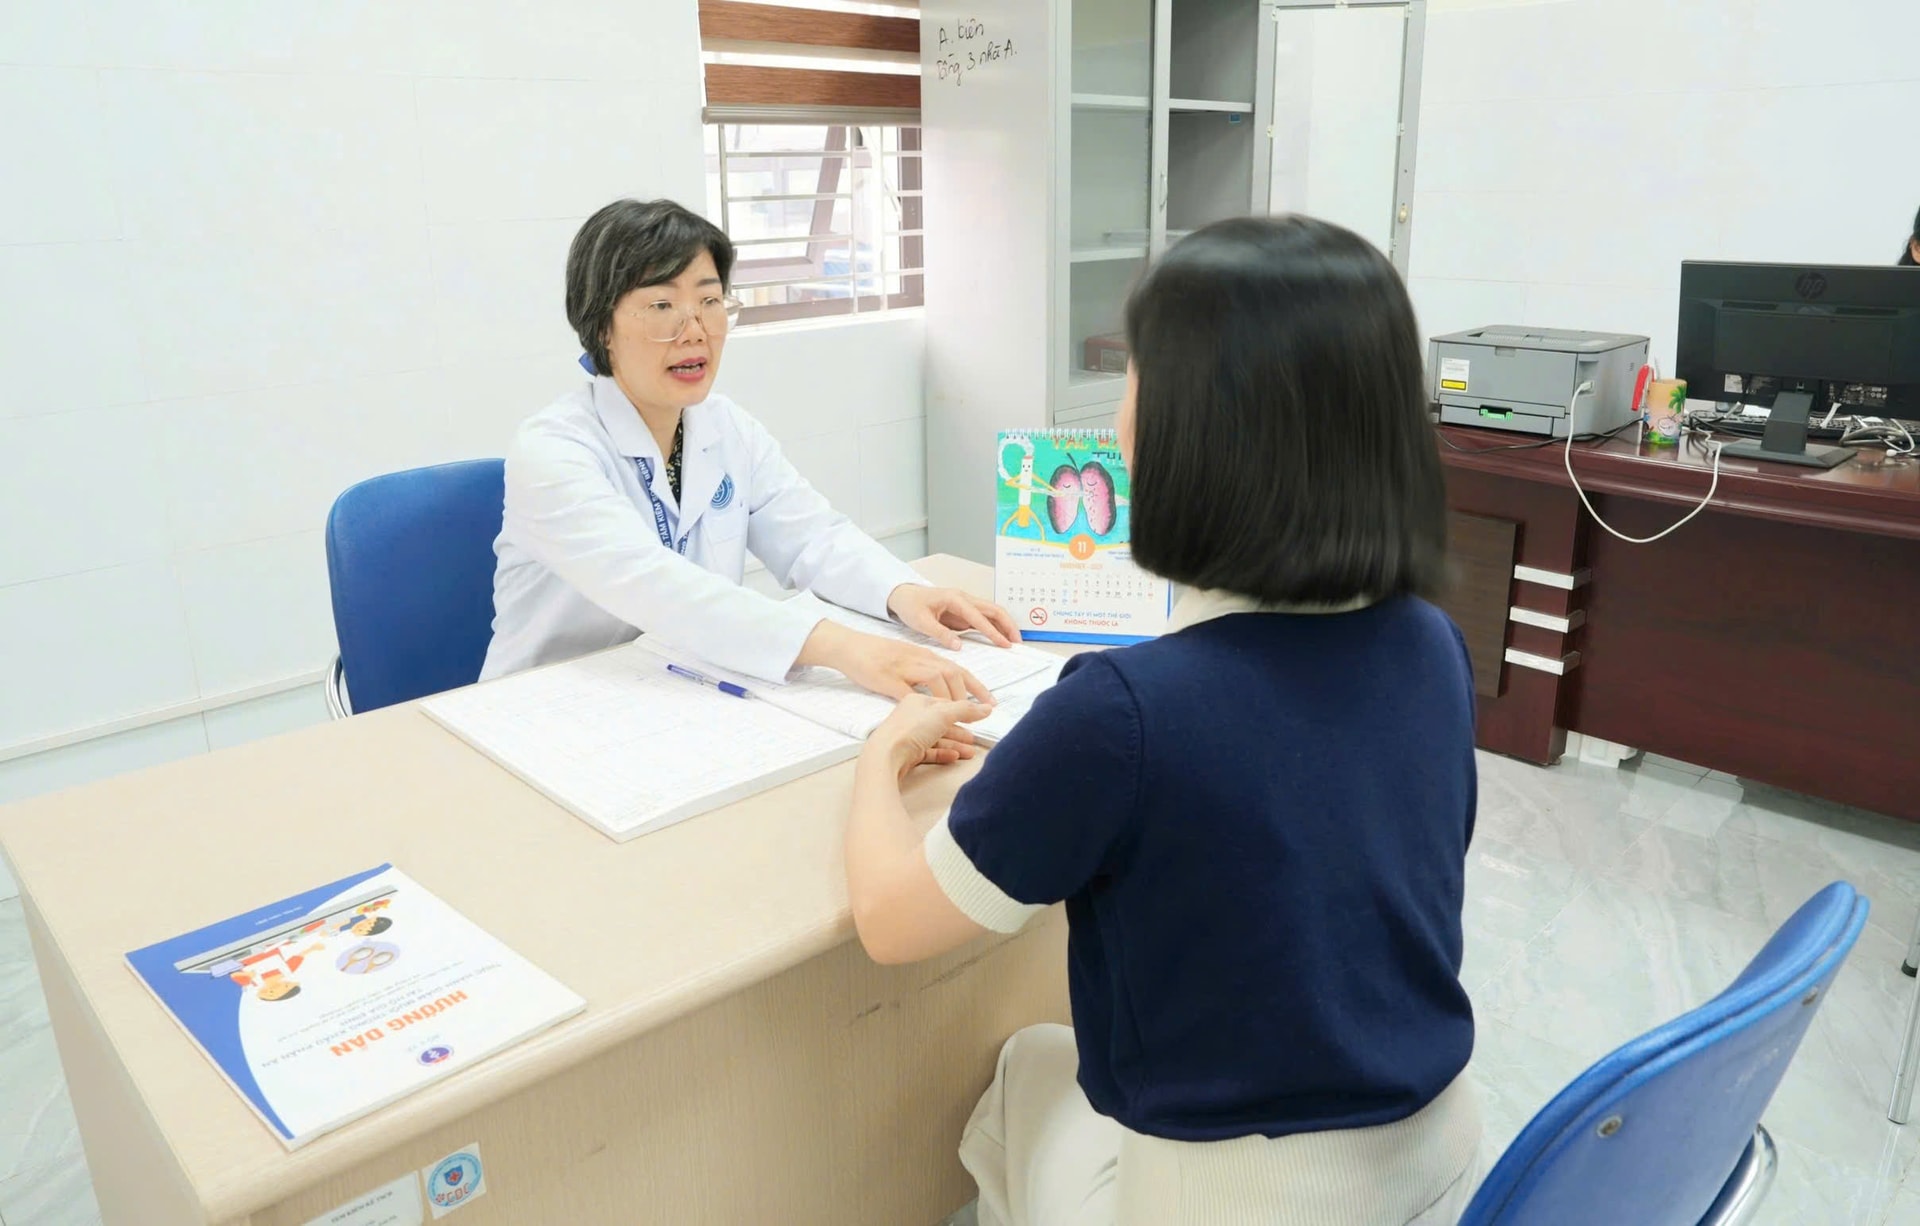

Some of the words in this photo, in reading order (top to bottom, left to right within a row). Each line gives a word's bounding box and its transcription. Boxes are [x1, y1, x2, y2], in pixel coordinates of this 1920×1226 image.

[966, 52, 976, 70] 3
[1077, 542, 1087, 554] 11
[386, 989, 469, 1031] HƯỚNG
